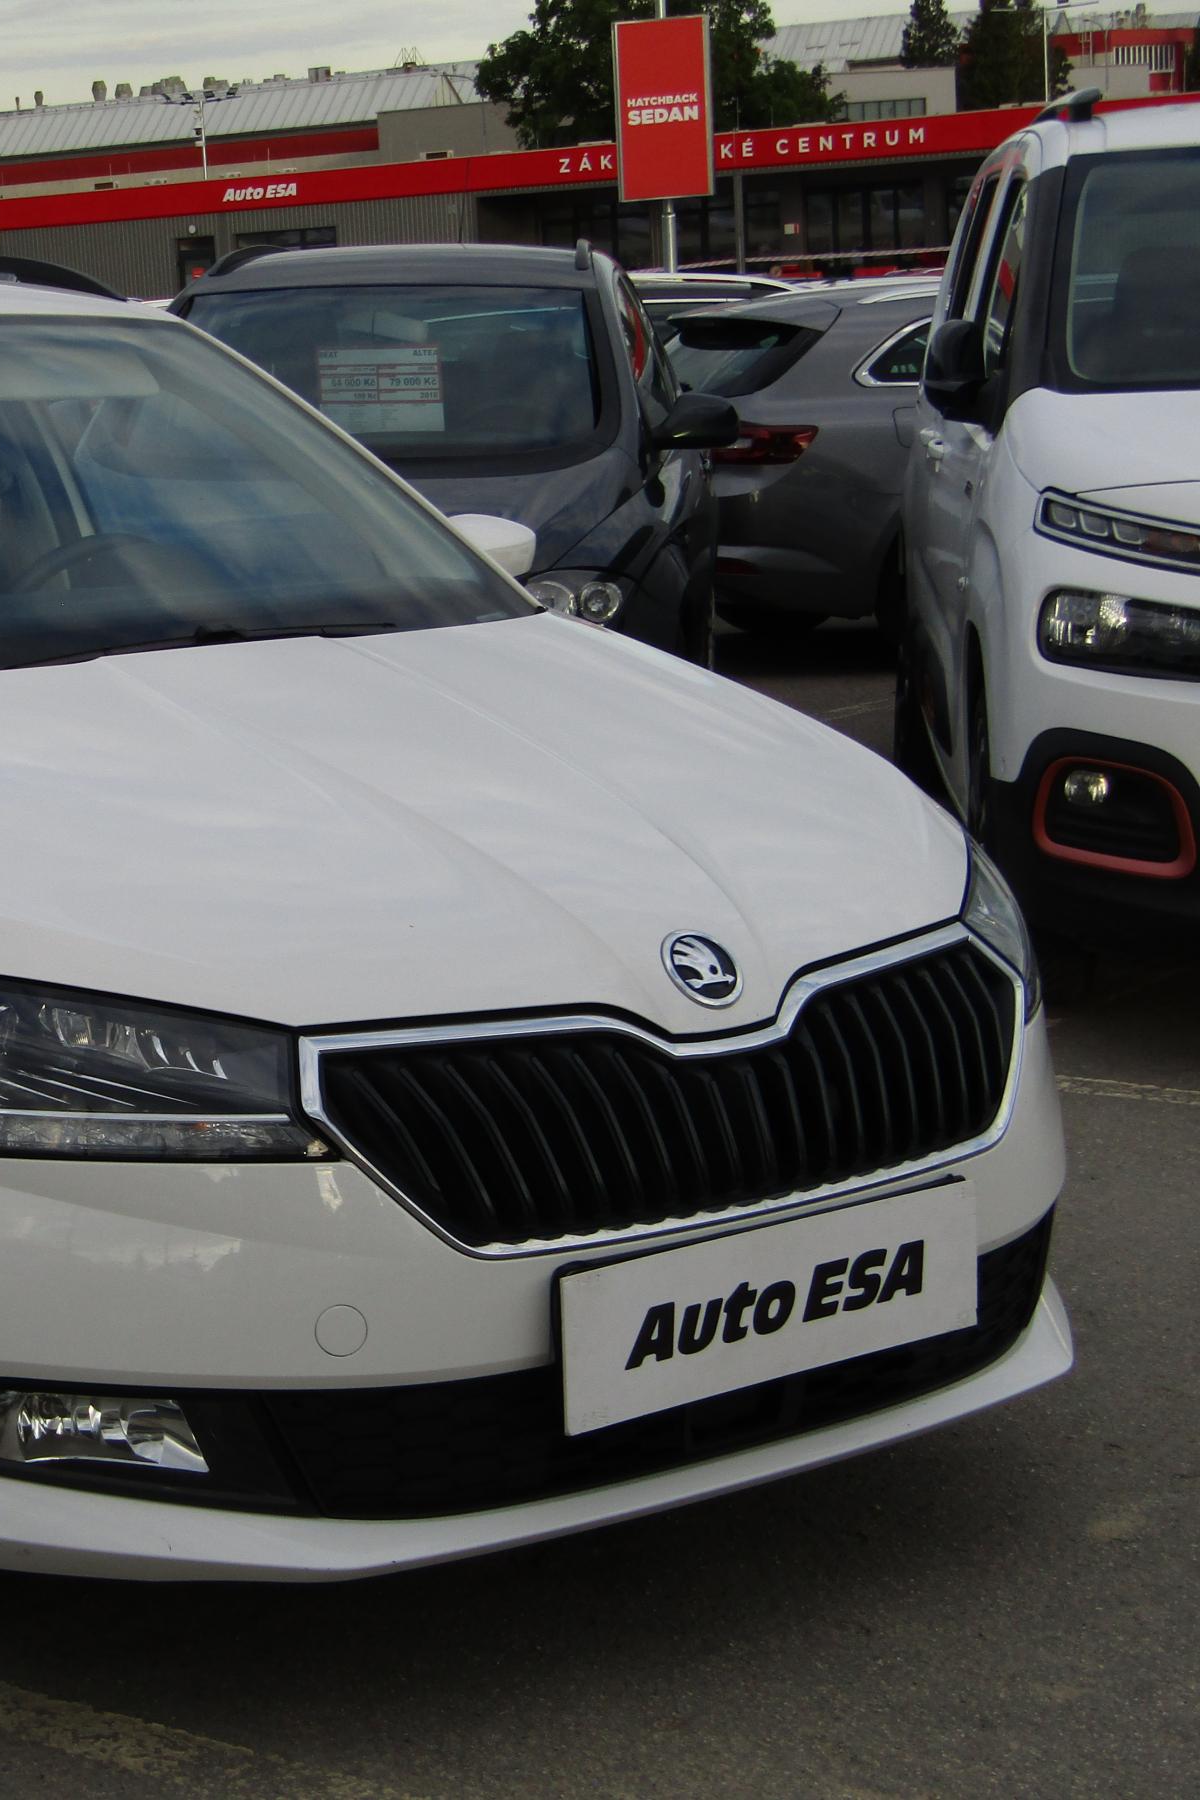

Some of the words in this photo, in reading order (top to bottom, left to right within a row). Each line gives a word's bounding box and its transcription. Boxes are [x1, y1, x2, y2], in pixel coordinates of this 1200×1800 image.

[627, 93, 698, 107] HATCHBACK
[628, 105, 699, 126] SEDAN
[775, 127, 925, 155] CENTRUM
[222, 186, 264, 202] Auto
[265, 182, 297, 199] ESA
[624, 1280, 796, 1371] Auto
[802, 1239, 925, 1323] ESA
